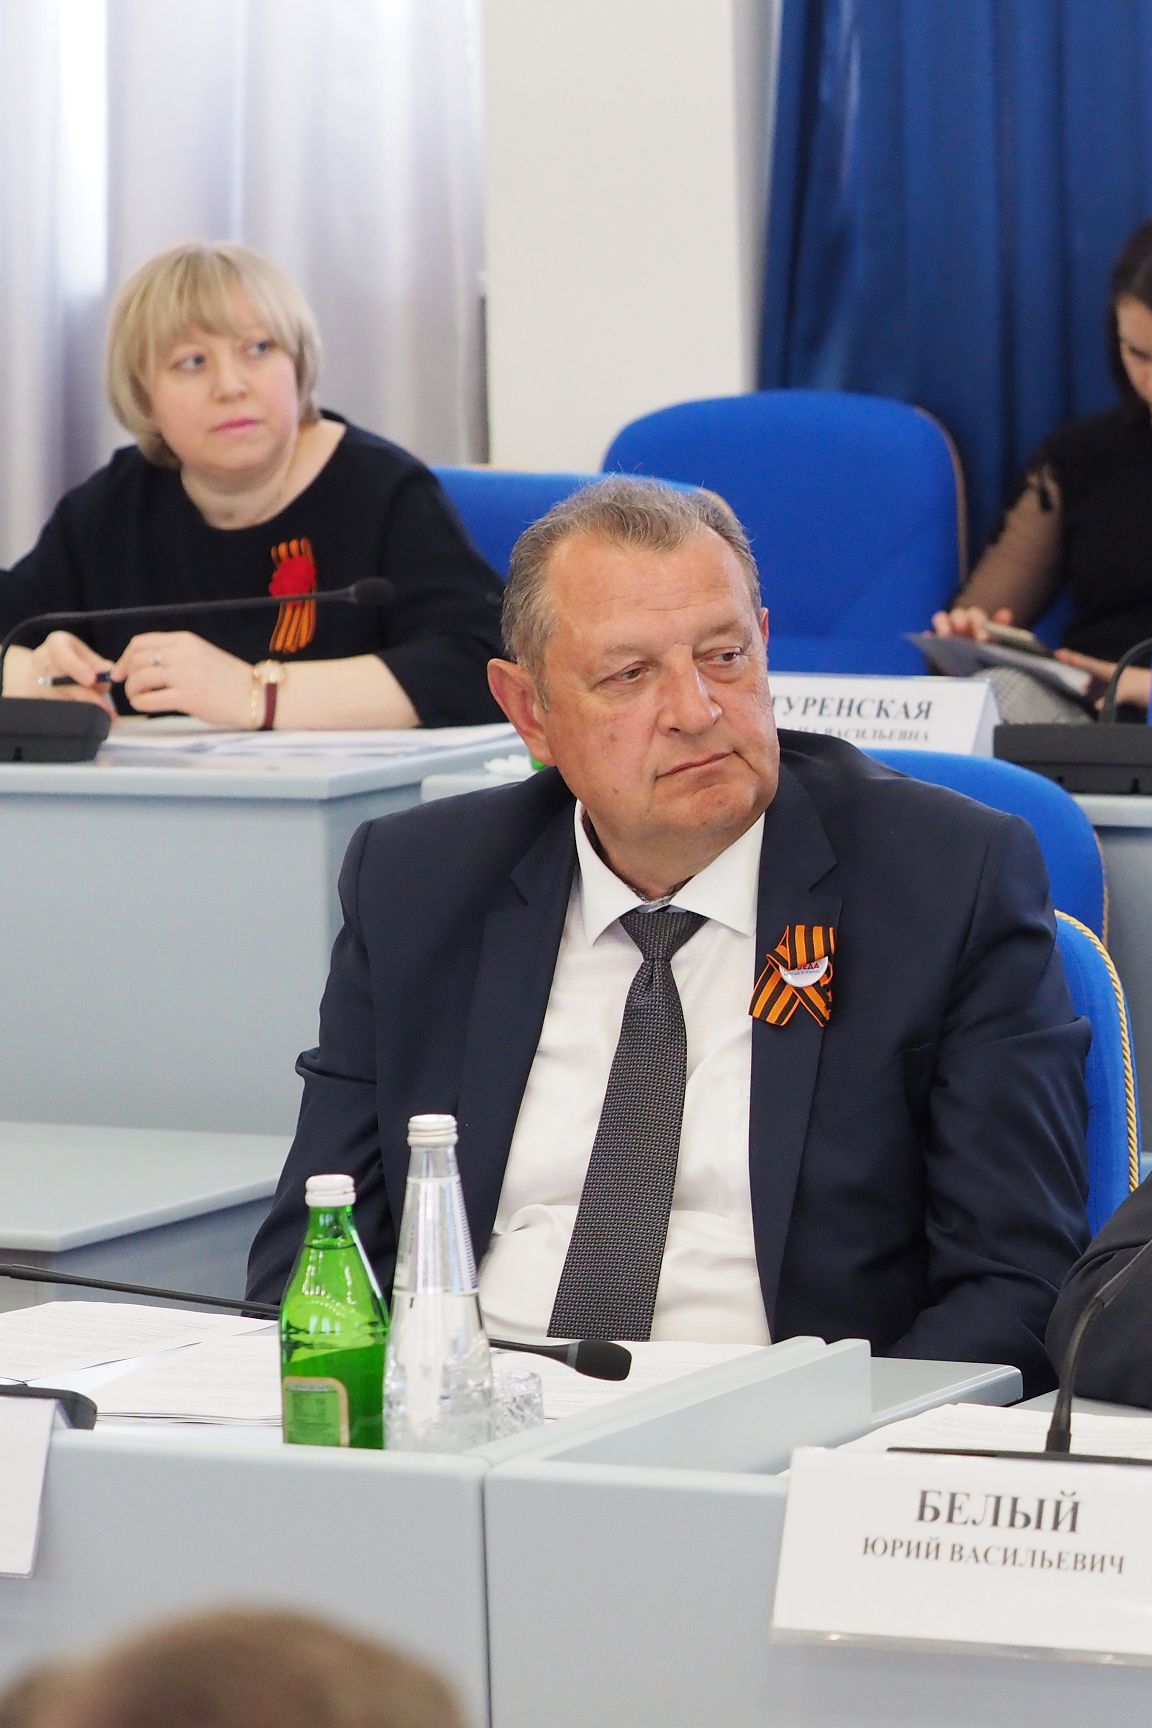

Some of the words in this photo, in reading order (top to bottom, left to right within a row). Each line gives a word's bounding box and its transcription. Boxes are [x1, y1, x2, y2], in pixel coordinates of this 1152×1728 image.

[915, 1488, 1081, 1533] БЕЛЫЙ
[862, 1535, 940, 1562] ЮРИЙ
[949, 1542, 1125, 1575] ВАСИЛЬЕВИЧ
